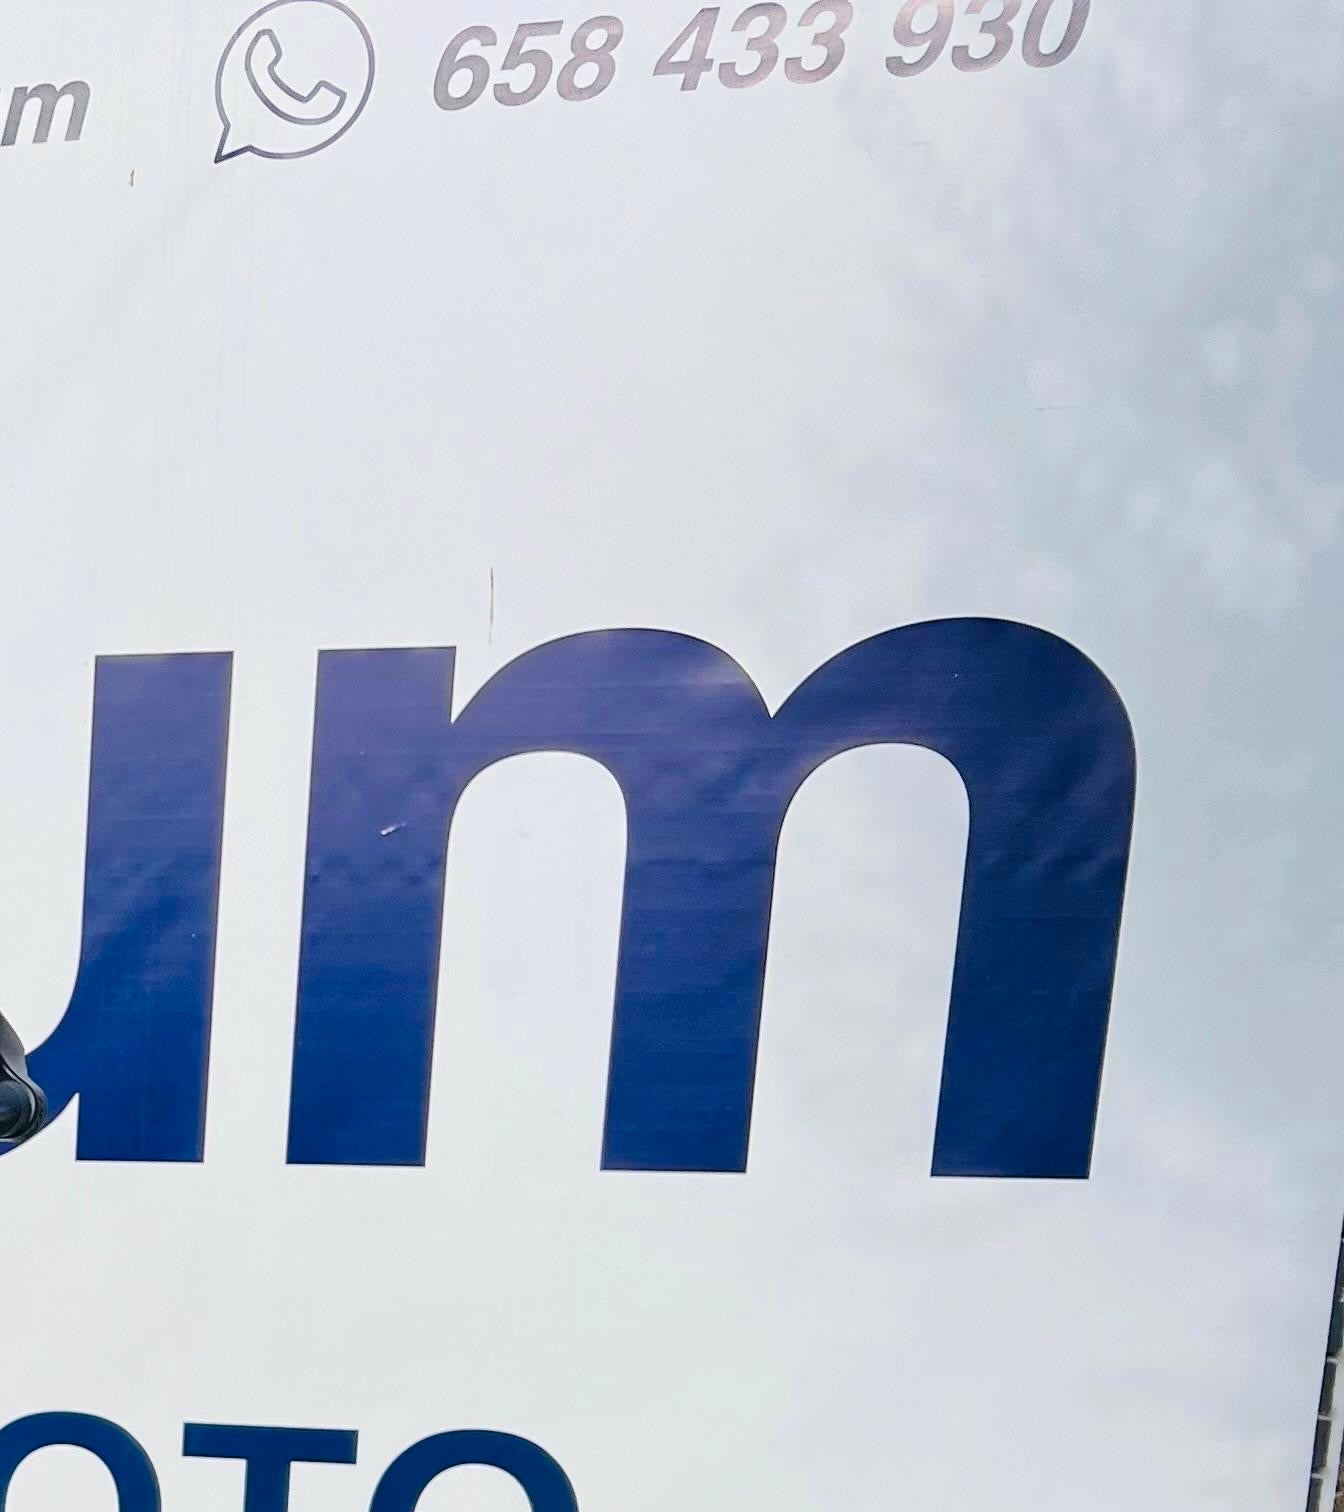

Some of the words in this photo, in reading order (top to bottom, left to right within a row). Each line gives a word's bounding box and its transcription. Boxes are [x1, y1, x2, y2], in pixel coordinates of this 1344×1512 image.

[432, 15, 624, 112] 658
[653, 1, 853, 91] 433
[885, 0, 1090, 78] 930
